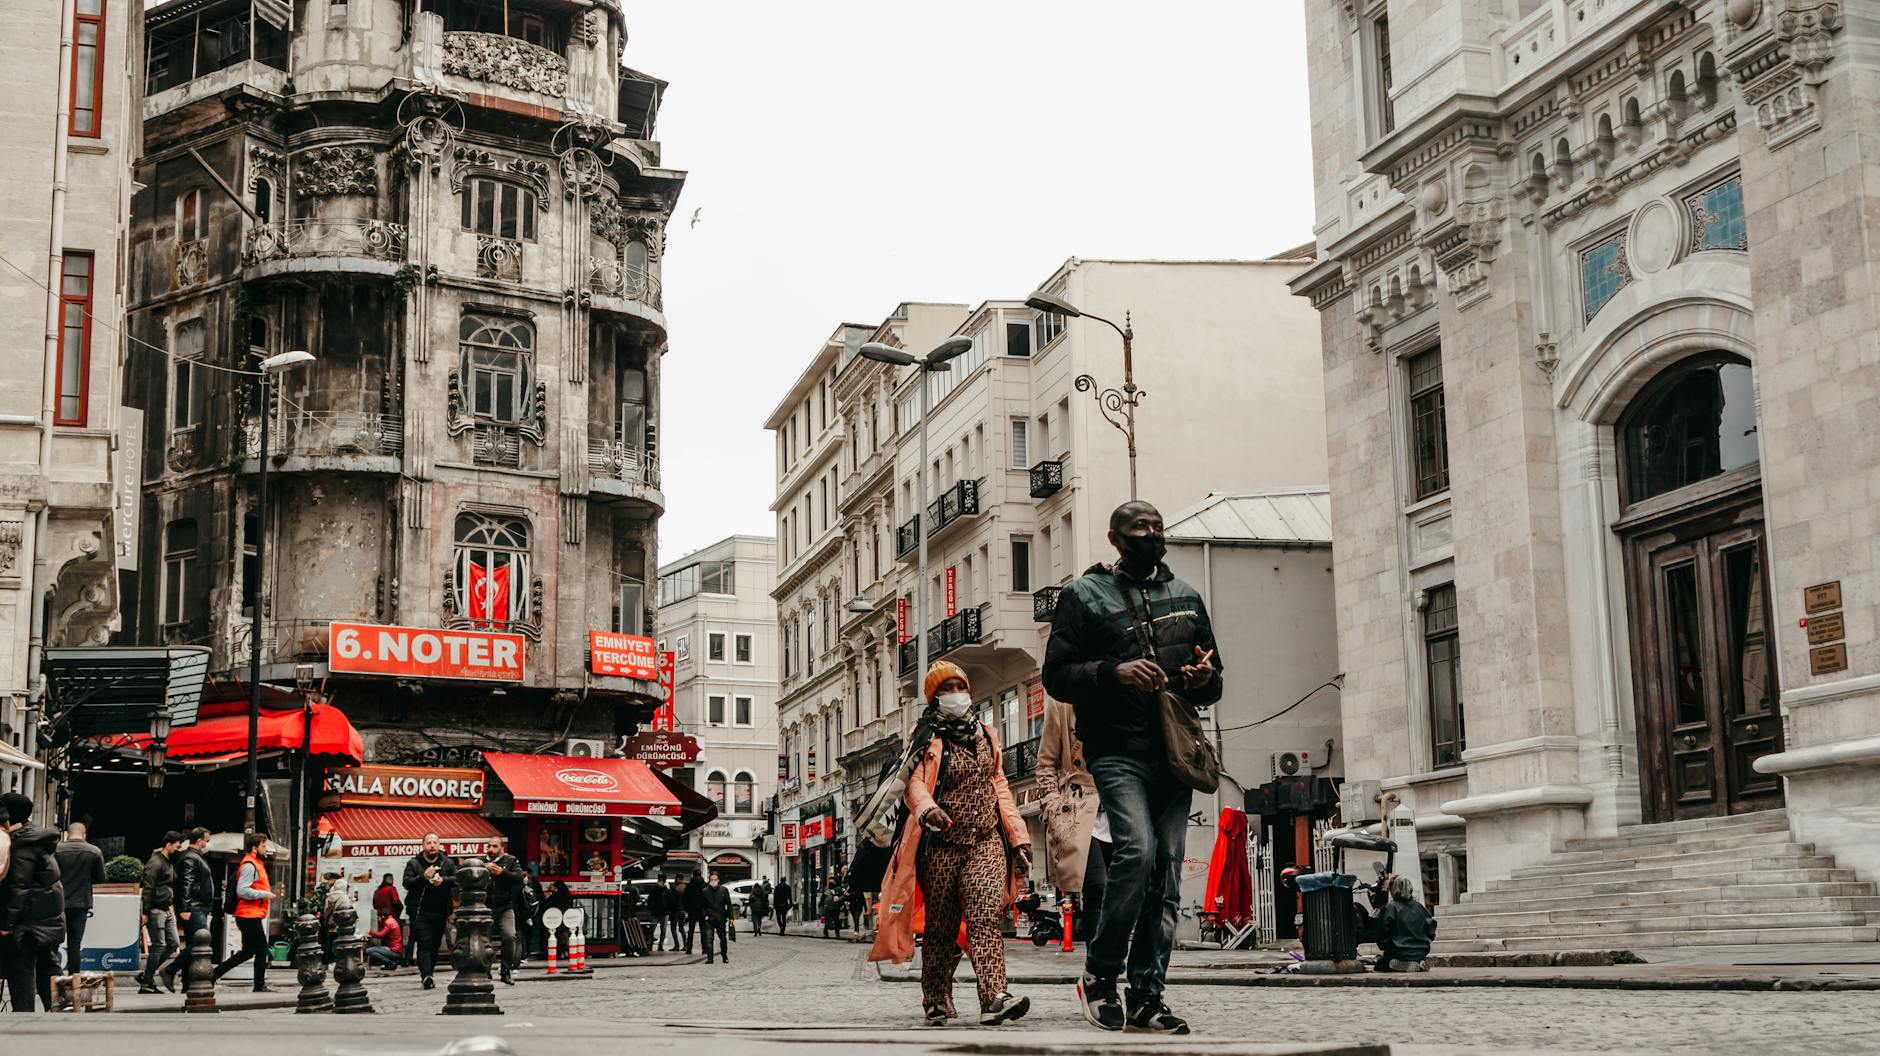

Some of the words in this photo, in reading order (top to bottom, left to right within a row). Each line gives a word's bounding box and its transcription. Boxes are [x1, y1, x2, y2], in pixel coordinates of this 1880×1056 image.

[125, 422, 137, 470] HOTEL
[595, 635, 651, 653] EMNİYET
[594, 650, 655, 668] TERCÜME
[640, 743, 682, 752] EMİNÖNÜ
[636, 752, 687, 760] DÜRÜMCÜSÜ
[389, 776, 483, 804] KOKOREÇ
[527, 801, 558, 812] EMİNÖNÜ
[566, 802, 606, 814] DÜRÜMCÜSÜ
[784, 825, 794, 837] E
[351, 846, 379, 856] GALA
[450, 842, 479, 854] PİLAV
[785, 842, 794, 852] E
